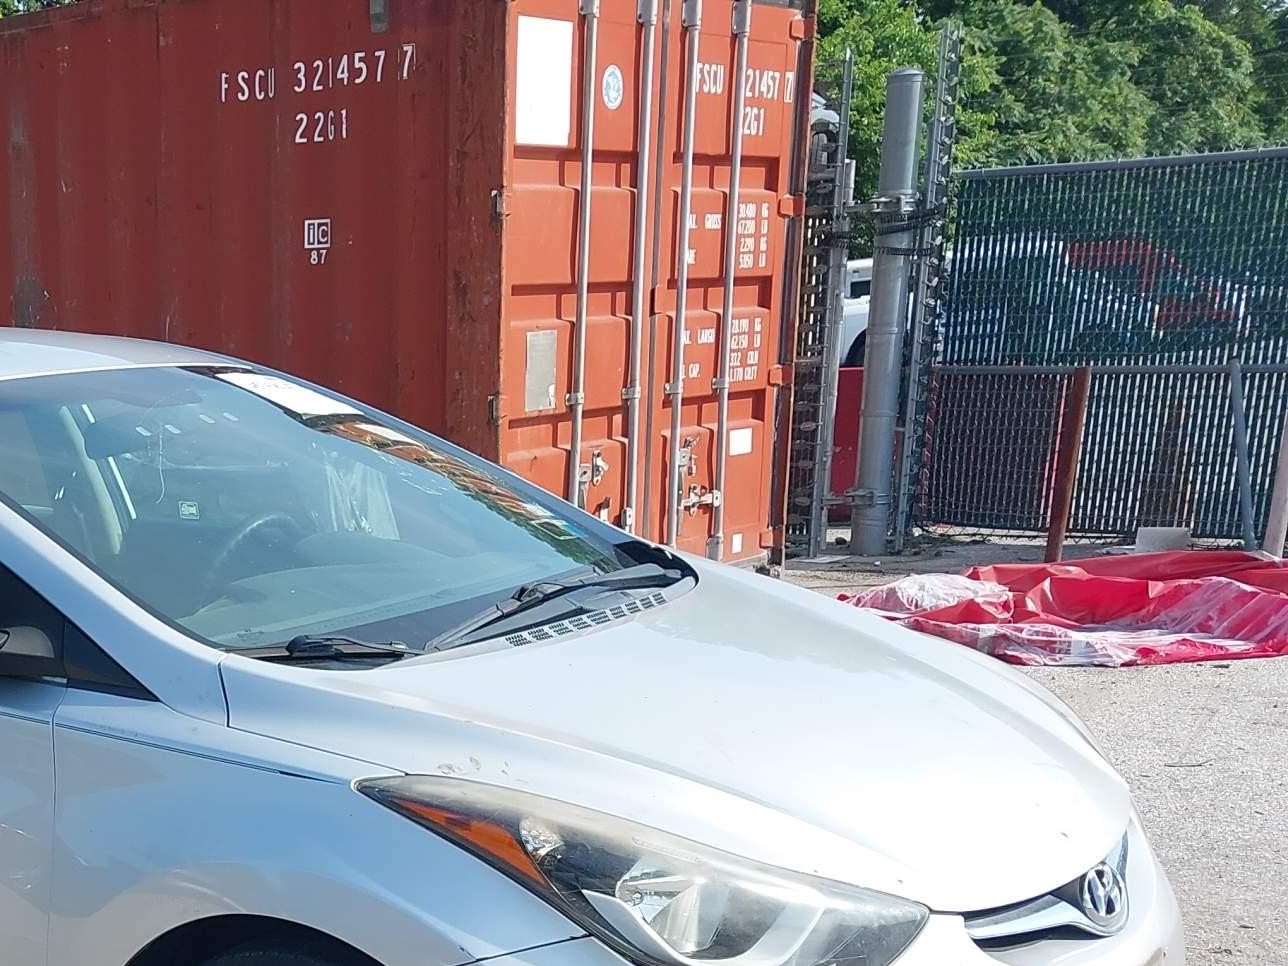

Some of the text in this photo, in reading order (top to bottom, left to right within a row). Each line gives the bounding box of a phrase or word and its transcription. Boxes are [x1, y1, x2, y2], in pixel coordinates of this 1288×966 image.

[221, 45, 414, 102] FSCU 321457 7
[695, 62, 793, 101] FSCU 21457 7
[295, 108, 347, 143] 22G1
[743, 105, 765, 136] 2G1
[310, 249, 328, 265] 87
